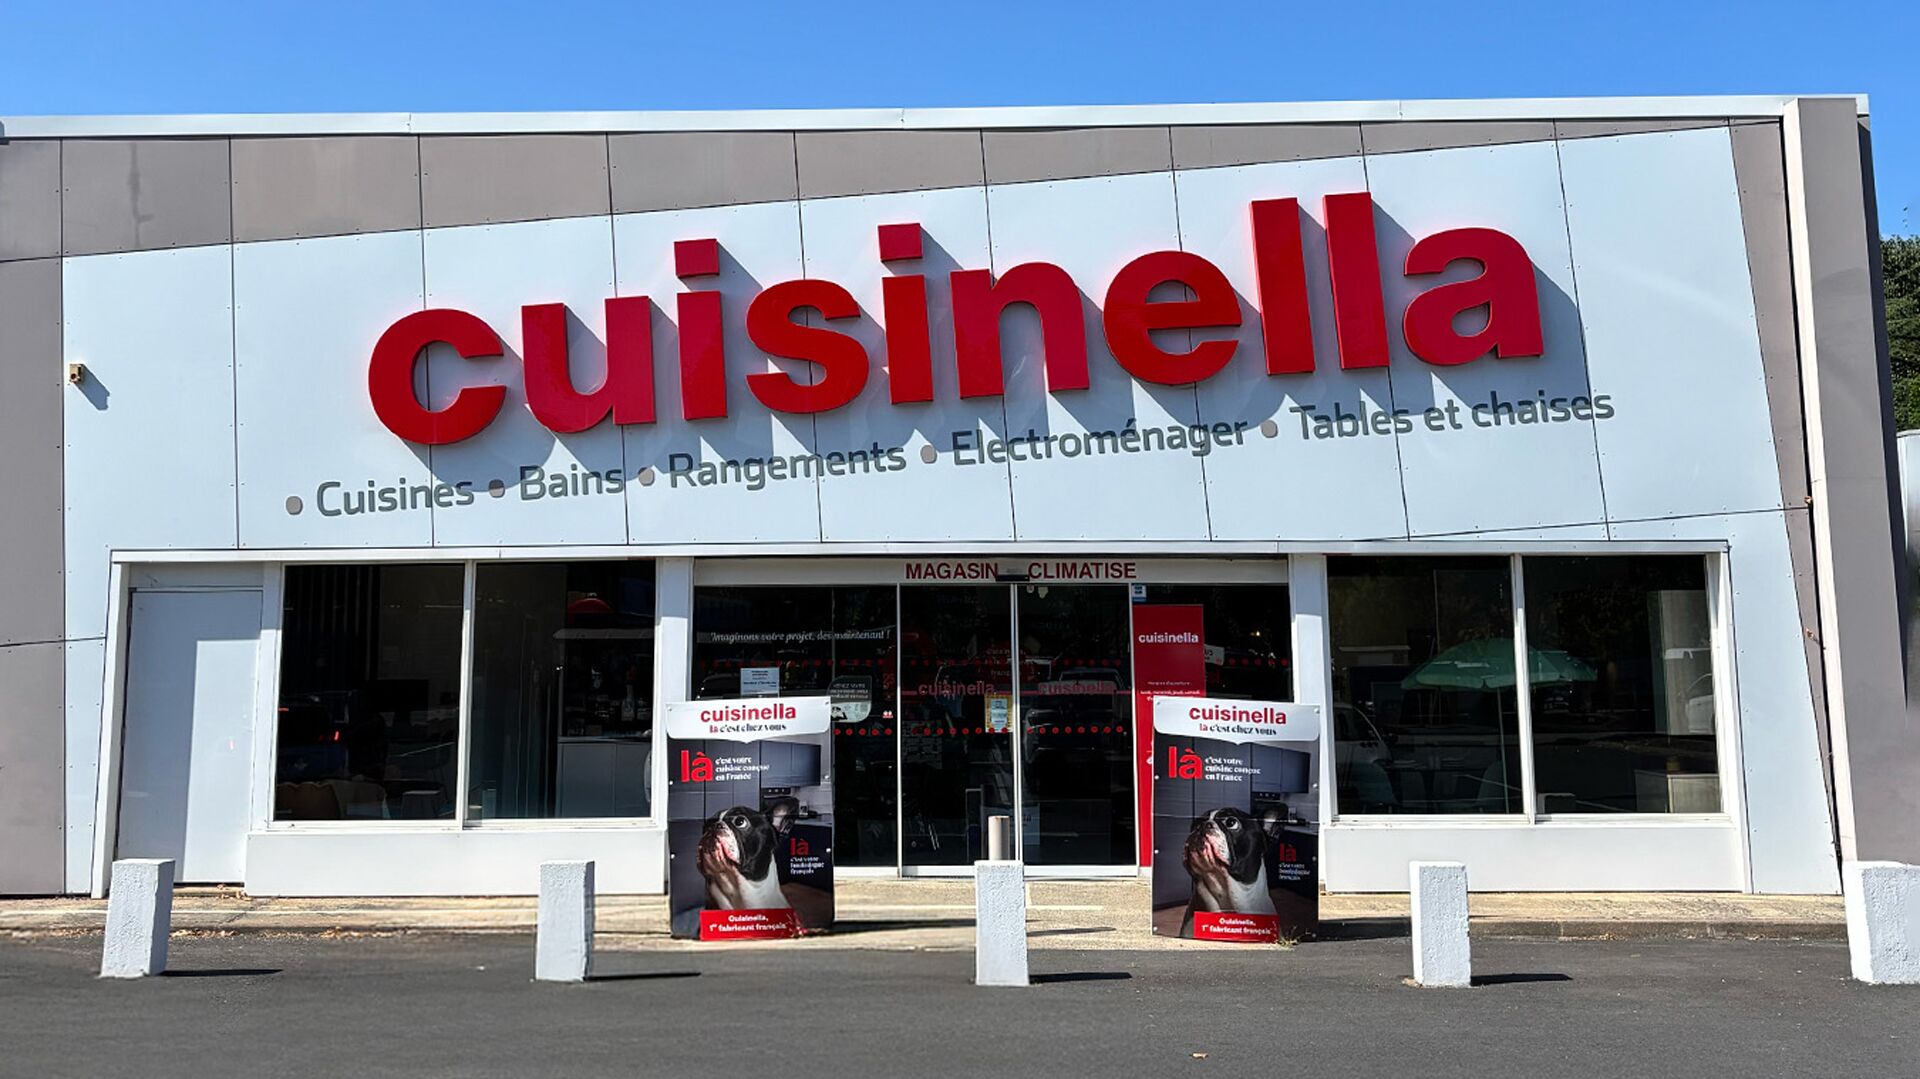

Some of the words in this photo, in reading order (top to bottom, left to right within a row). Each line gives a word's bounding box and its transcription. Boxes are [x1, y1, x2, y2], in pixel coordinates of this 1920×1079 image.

[367, 191, 1546, 446] cuisinella
[316, 478, 475, 517] Cuisines
[519, 464, 624, 502] Bains
[669, 441, 907, 496] Rangements
[952, 416, 1248, 467] Electroménager
[1289, 400, 1409, 440] Tables
[1423, 401, 1463, 432] et
[1471, 390, 1616, 426] chaises
[905, 562, 998, 579] MAGASIN
[1028, 562, 1136, 579] CLIMATISE
[1138, 632, 1199, 644] cuisinella
[918, 680, 995, 696] cuisinella
[700, 704, 797, 723] cuisinella
[1189, 704, 1287, 725] cuisinella
[741, 723, 763, 732] chez
[1232, 724, 1254, 735] chez
[1254, 727, 1278, 736] vous
[680, 749, 714, 783] là
[1168, 746, 1203, 780] là
[718, 923, 755, 932] fabricant
[1209, 924, 1242, 934] fabricant
